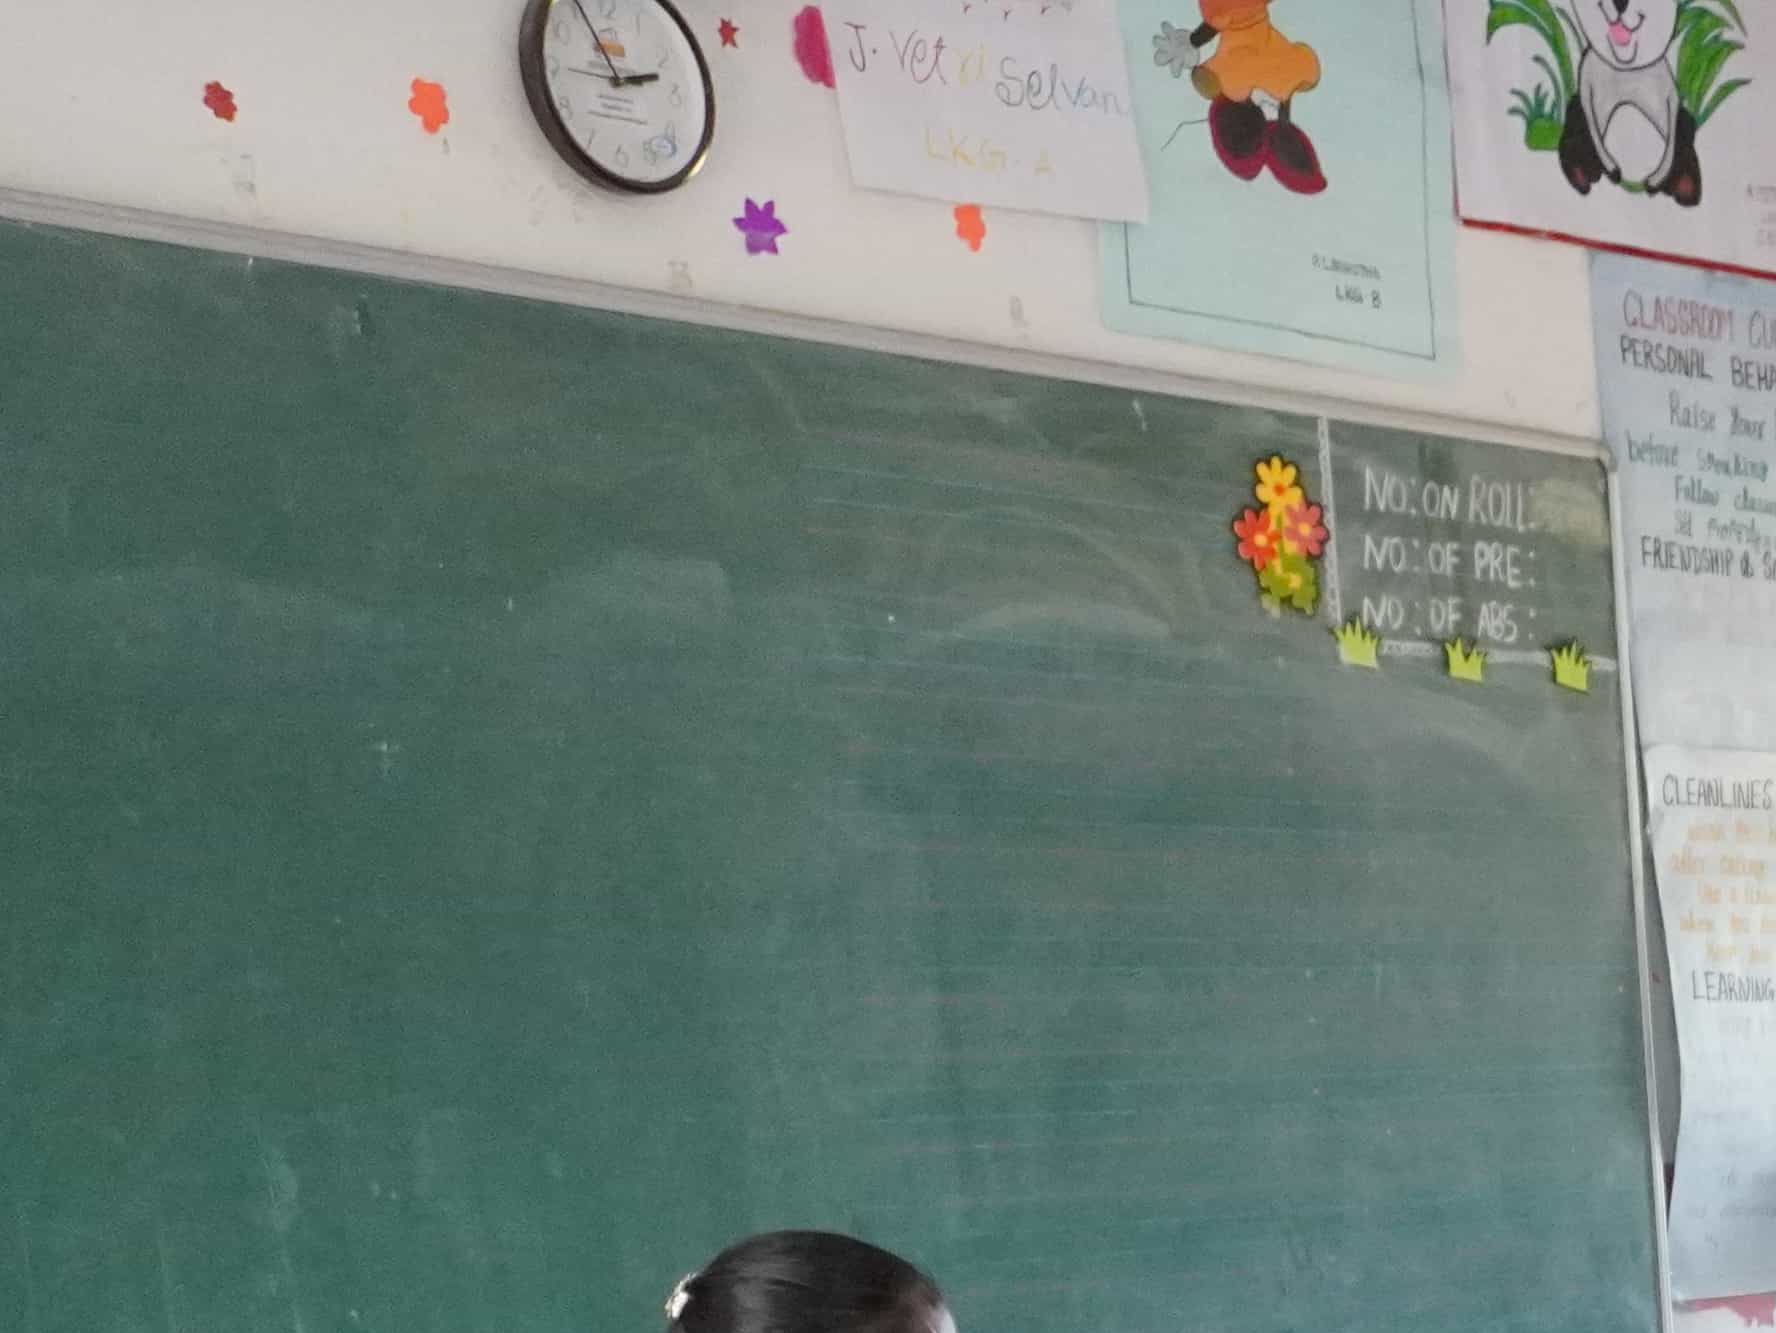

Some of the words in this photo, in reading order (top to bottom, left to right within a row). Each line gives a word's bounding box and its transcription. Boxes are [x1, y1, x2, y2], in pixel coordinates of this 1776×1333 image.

[1623, 289, 1734, 342] CLASSROOM
[1620, 334, 1712, 380] PERSONAL
[1668, 389, 1716, 432] Raise
[1428, 542, 1460, 577] OF
[1641, 536, 1734, 577] FRIENDSHIP
[1430, 597, 1462, 634] OF
[1662, 774, 1773, 810] CLEANLINES
[1692, 969, 1775, 1003] LEARNING
